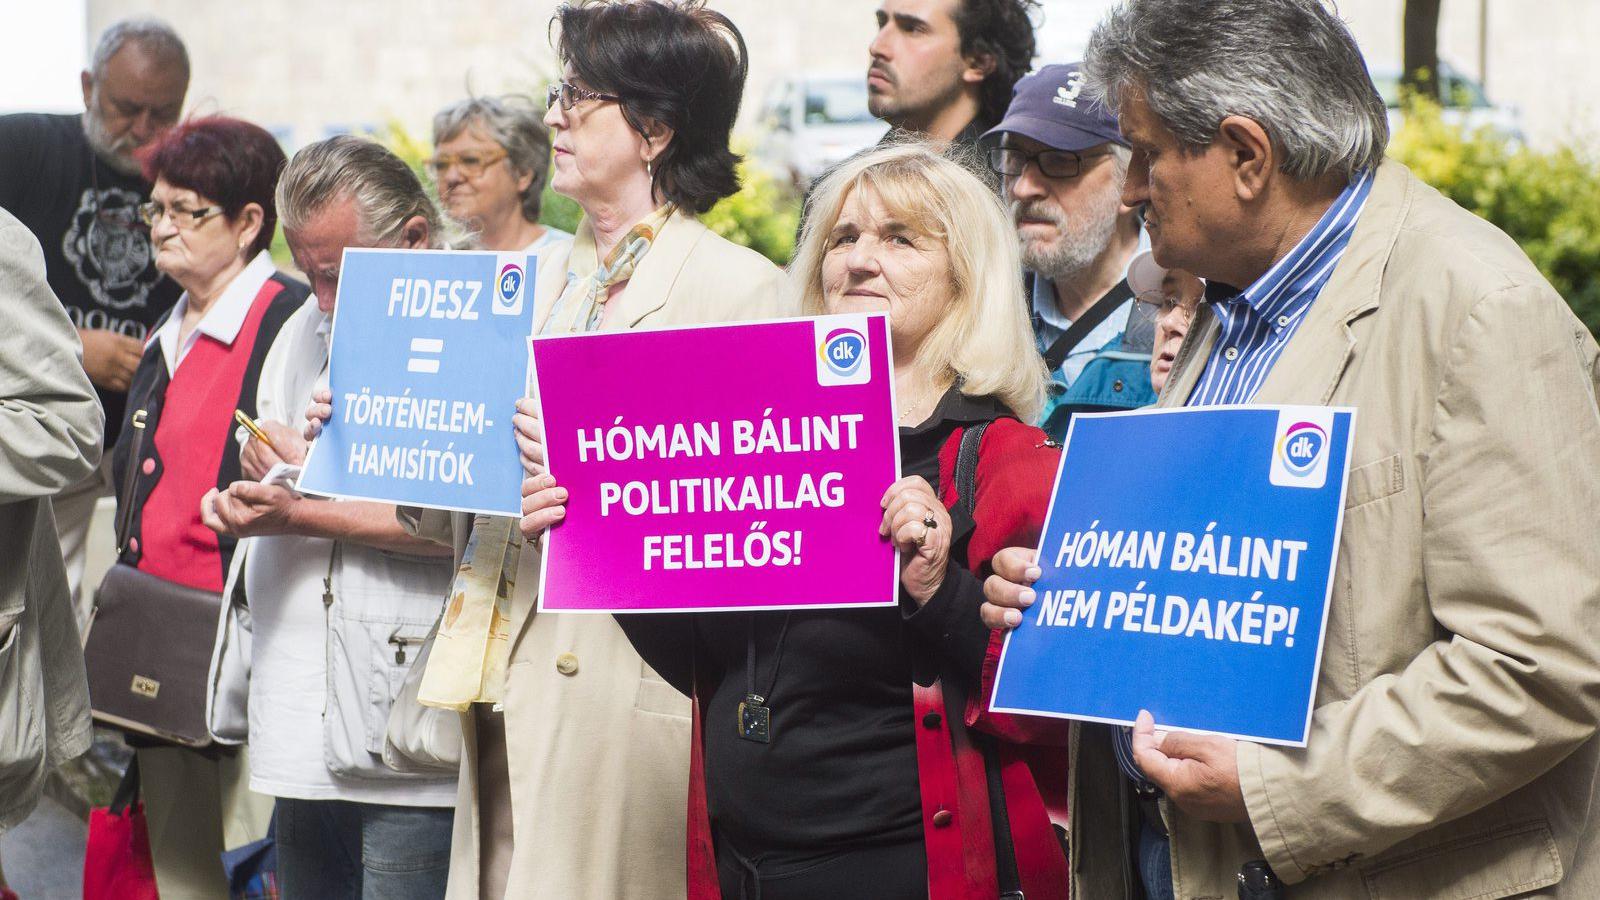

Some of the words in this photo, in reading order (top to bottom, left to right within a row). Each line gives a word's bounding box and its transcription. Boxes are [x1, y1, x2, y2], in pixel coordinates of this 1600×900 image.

[387, 277, 483, 321] FIDESZ
[503, 275, 517, 292] dk
[833, 341, 855, 360] dk
[344, 386, 494, 435] TÖRTÉNELEM-
[577, 415, 721, 463] HÓMAN
[732, 407, 864, 455] BÁLINT
[1290, 436, 1315, 458] dk
[348, 439, 475, 486] HAMISÍTÓK
[600, 471, 845, 517] POLITIKAILAG
[643, 520, 803, 571] FELELŐS!
[1054, 519, 1166, 570] HÓMAN
[1170, 521, 1308, 582] BÁLINT
[1035, 589, 1102, 629] NEM
[1103, 580, 1300, 648] PÉLDAKÉP!
